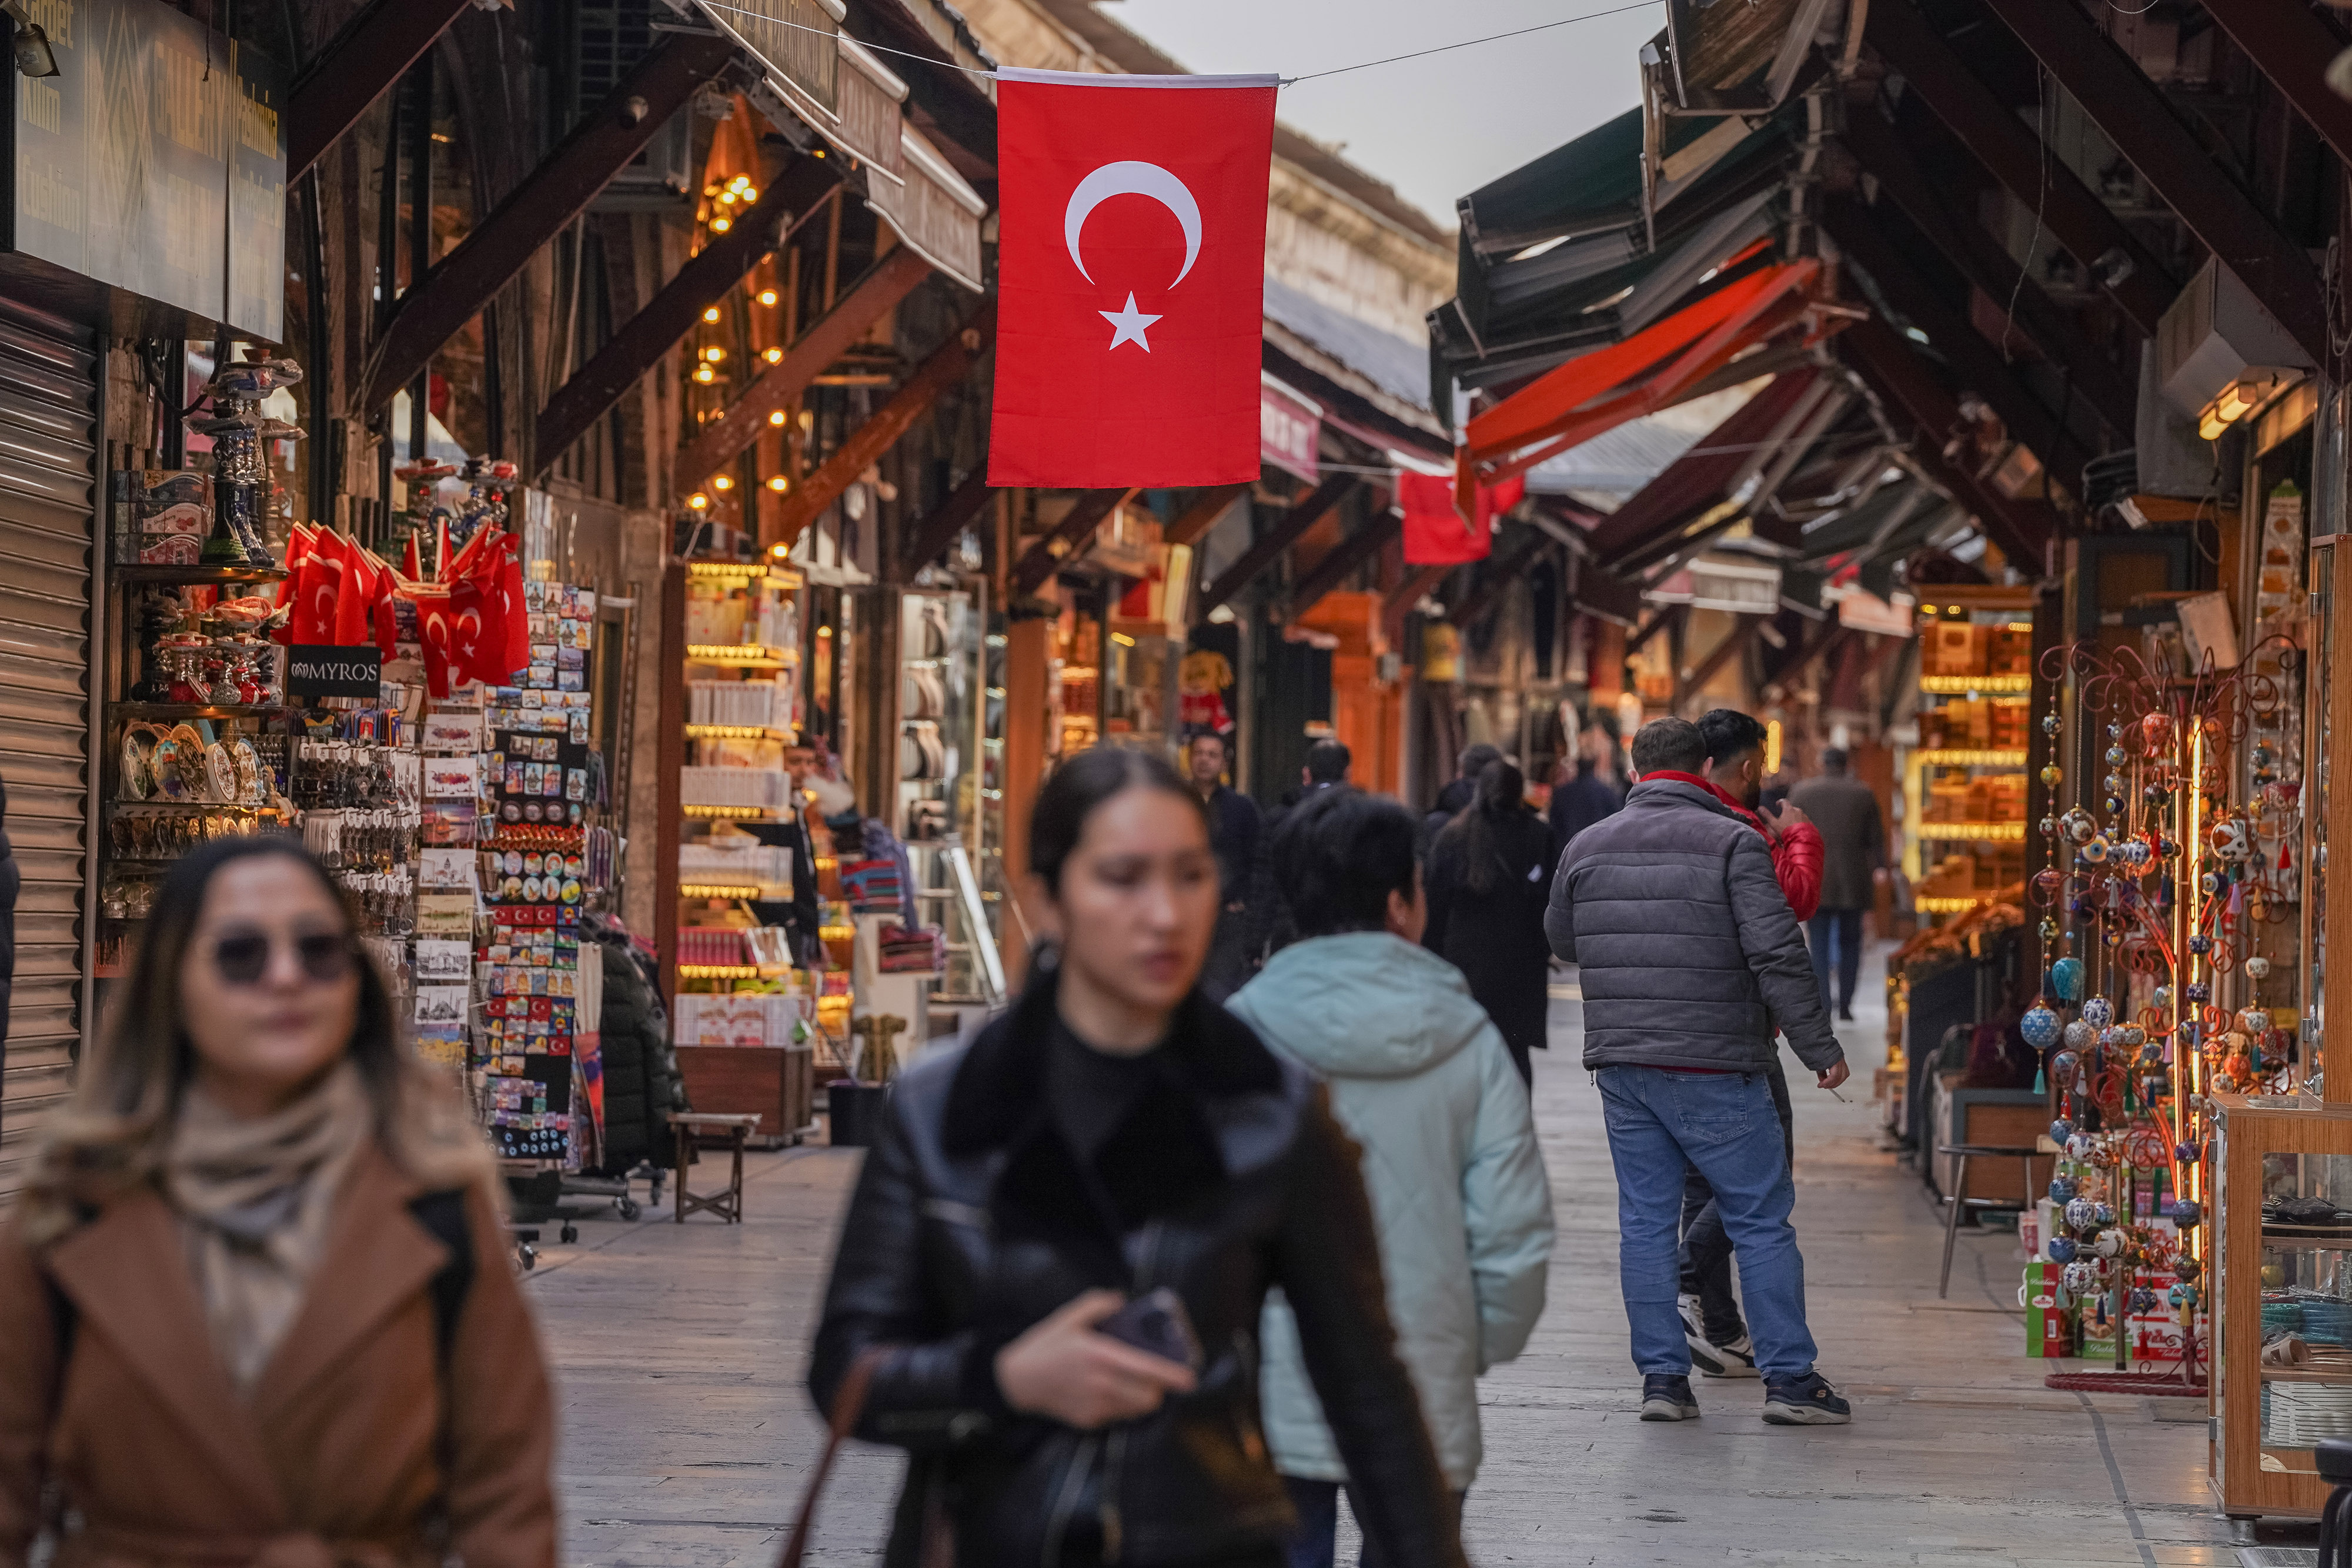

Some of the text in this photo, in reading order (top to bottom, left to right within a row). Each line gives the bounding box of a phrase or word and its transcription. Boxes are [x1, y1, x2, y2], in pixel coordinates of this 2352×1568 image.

[23, 76, 60, 136] Kilim
[155, 41, 227, 162] GALLERY
[236, 75, 278, 161] Pashmina
[22, 154, 80, 235] Cushion
[308, 663, 377, 681] MYROS
